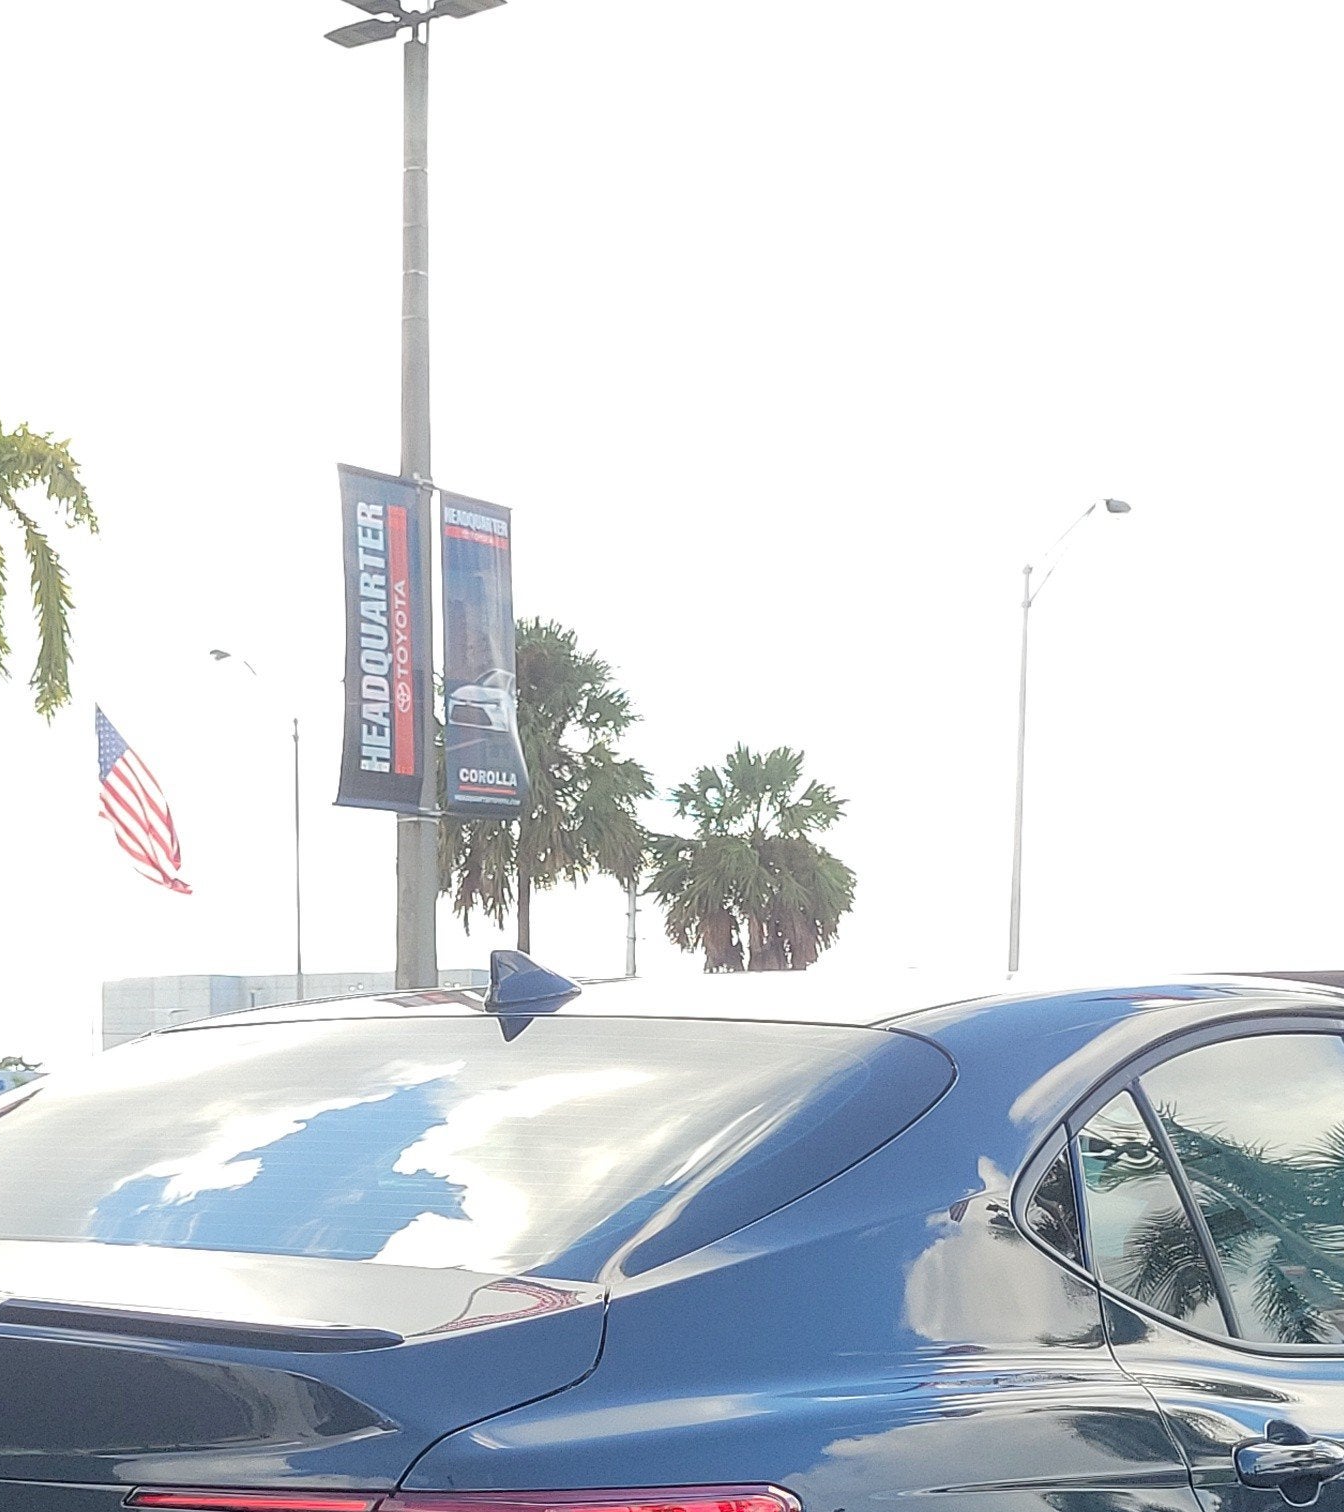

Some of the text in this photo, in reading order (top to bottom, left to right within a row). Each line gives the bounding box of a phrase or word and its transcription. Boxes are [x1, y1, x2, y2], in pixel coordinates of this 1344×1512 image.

[357, 501, 392, 773] HEADQUARTER
[394, 580, 411, 679] TOYOTA
[459, 768, 517, 786] COROLLA
